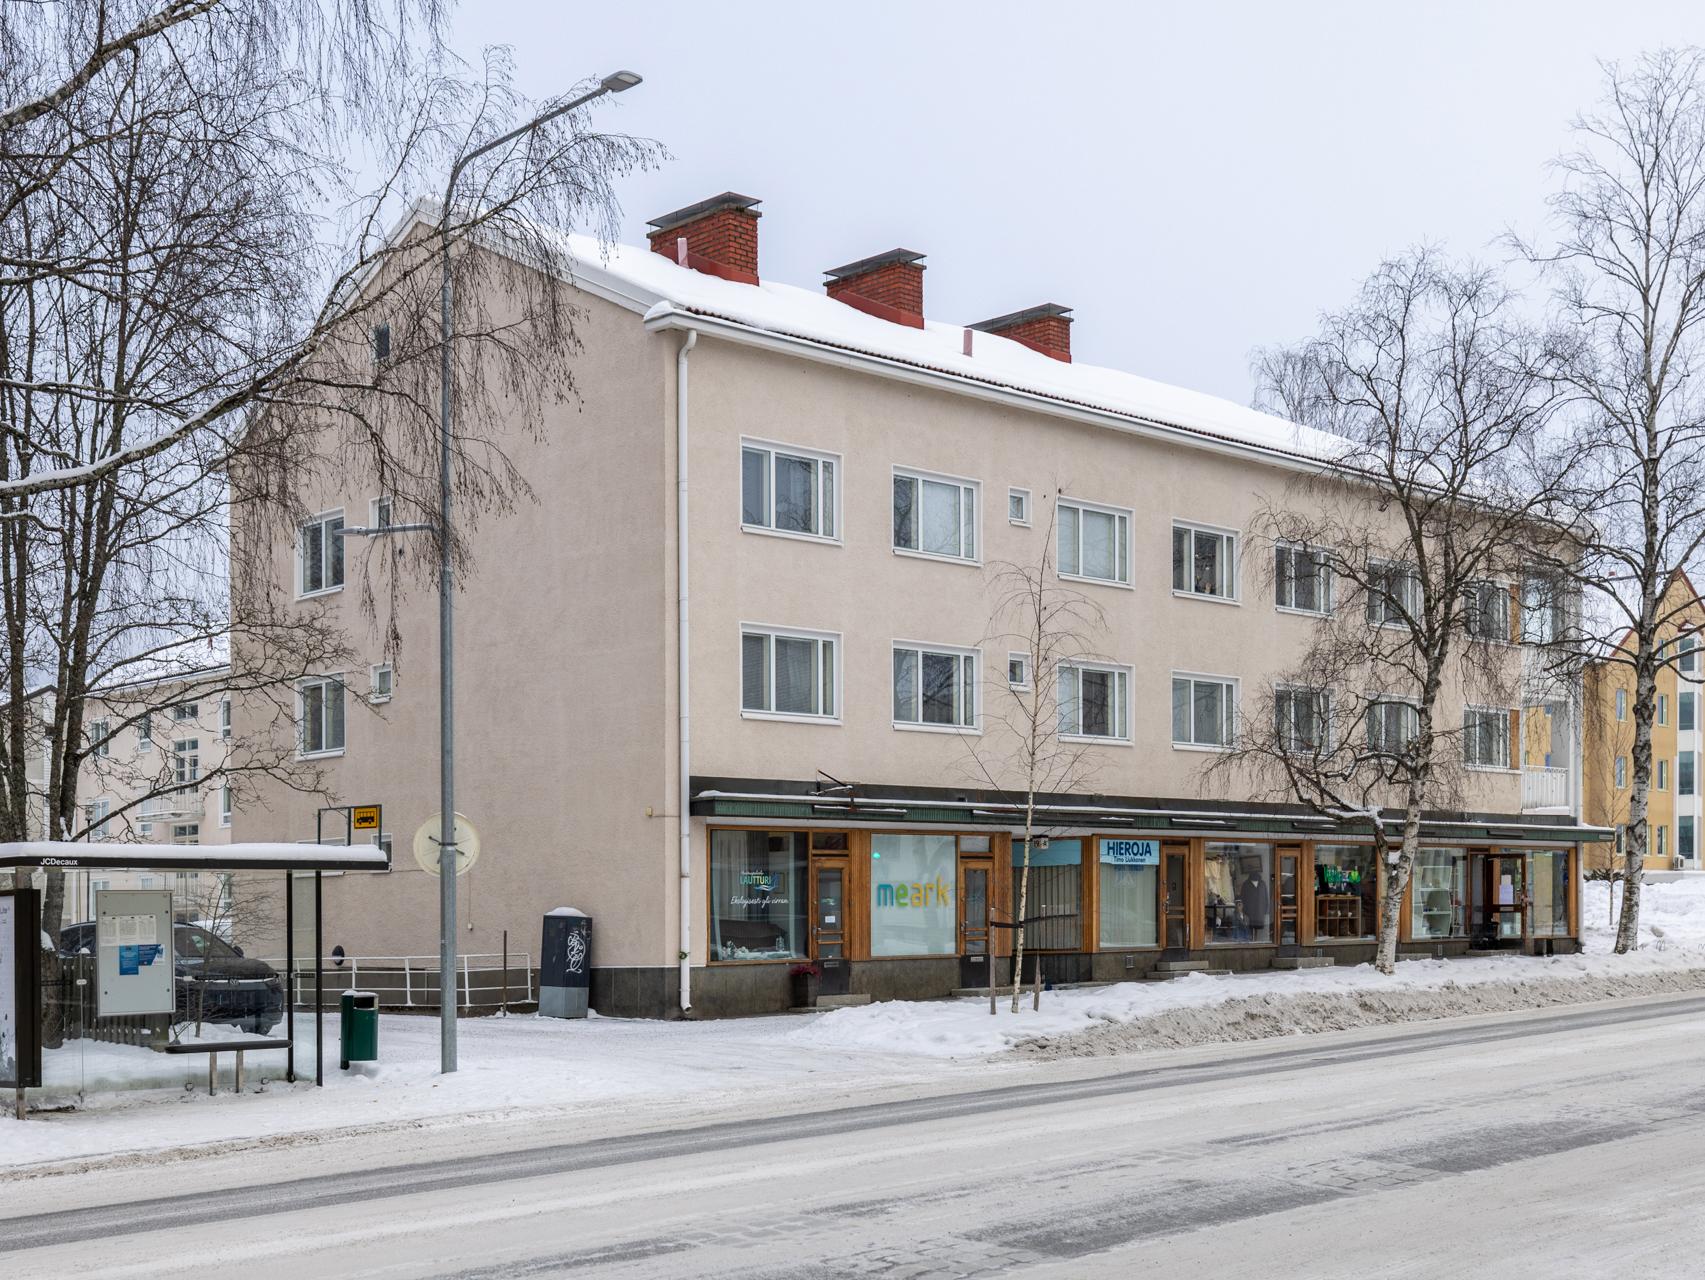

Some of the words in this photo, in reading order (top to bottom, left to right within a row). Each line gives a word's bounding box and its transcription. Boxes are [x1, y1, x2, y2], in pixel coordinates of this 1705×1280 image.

[1107, 841, 1152, 856] HIEROJA
[40, 857, 78, 866] JCDecaux
[877, 873, 949, 907] meark
